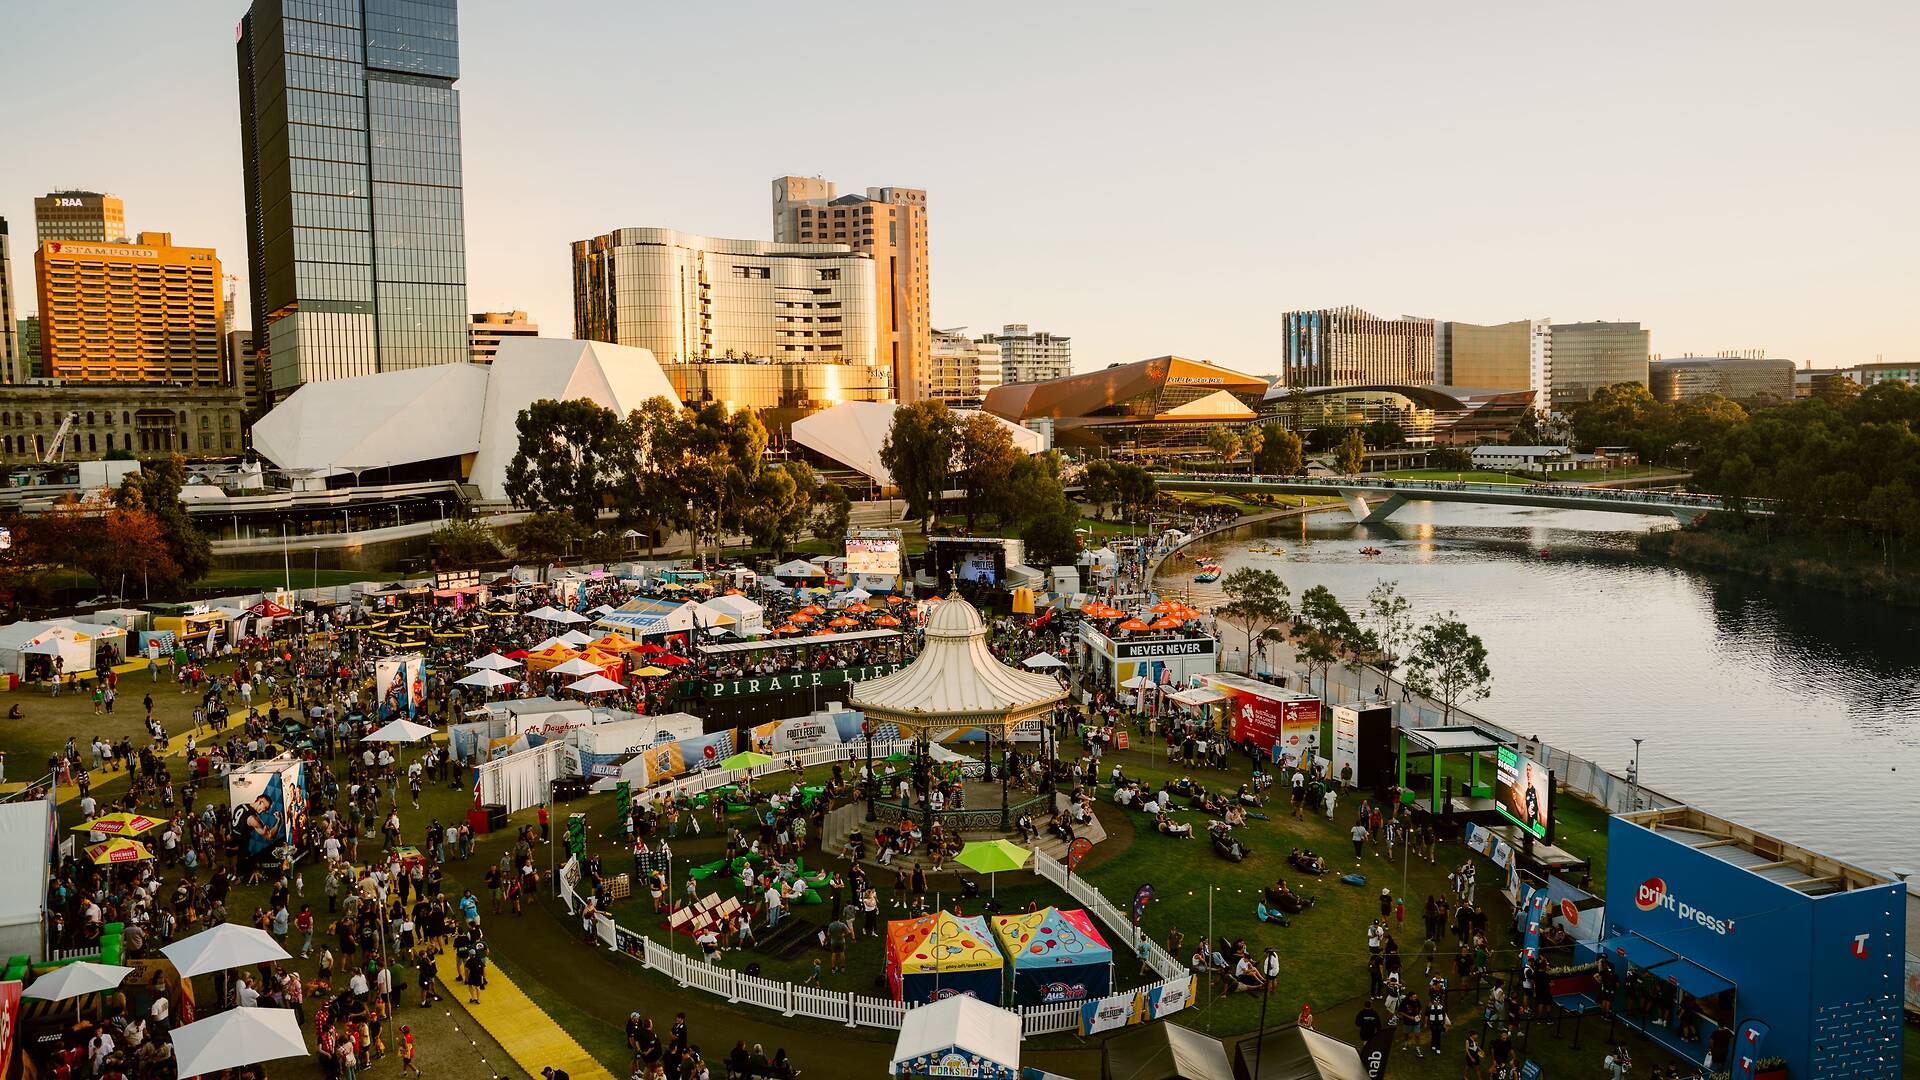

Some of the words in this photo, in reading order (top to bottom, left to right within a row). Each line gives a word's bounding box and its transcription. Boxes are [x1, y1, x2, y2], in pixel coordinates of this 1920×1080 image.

[62, 199, 83, 207] RAA
[65, 246, 153, 257] STAMFORD
[1129, 645, 1165, 656] NEVER
[1166, 643, 1201, 654] NEVER
[713, 672, 822, 697] PIRATE
[787, 729, 803, 738] FOOTY
[803, 726, 827, 736] FESTIVAL
[624, 743, 653, 753] ARCTIC
[1639, 884, 1675, 912] print
[1678, 901, 1726, 935] press
[1368, 1051, 1382, 1079] nab
[930, 1066, 978, 1077] WORKSHOP
